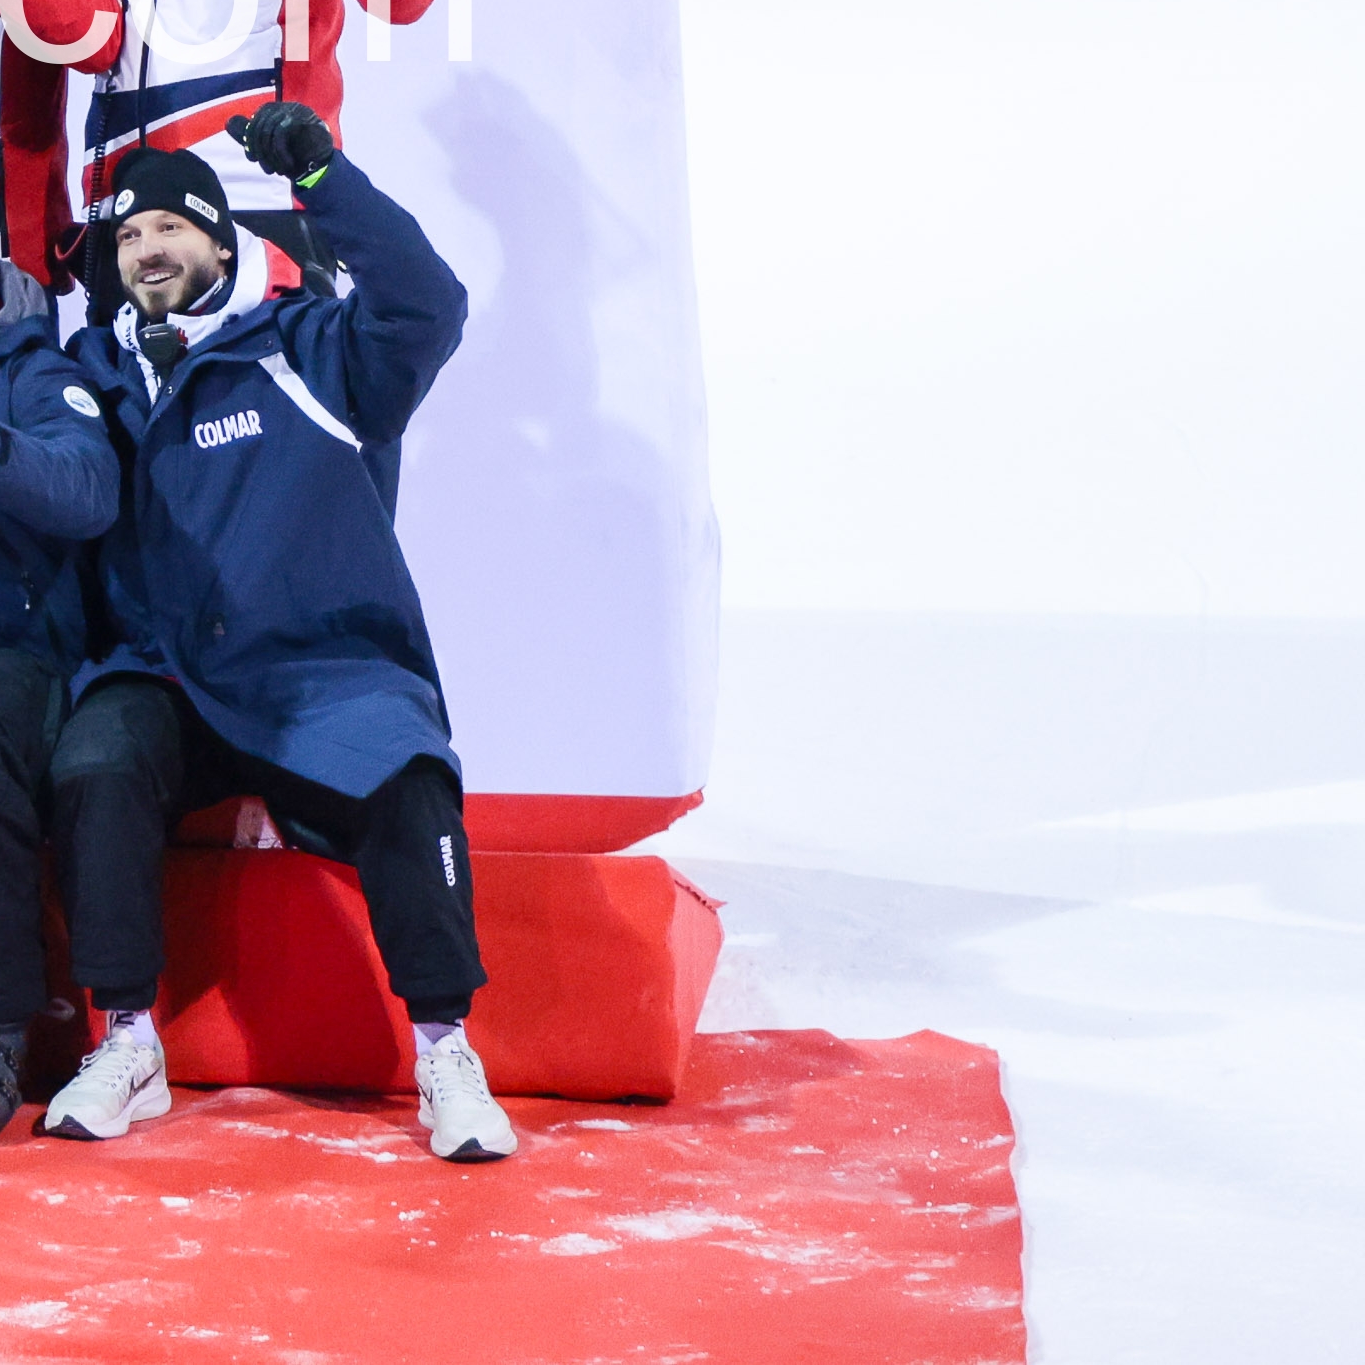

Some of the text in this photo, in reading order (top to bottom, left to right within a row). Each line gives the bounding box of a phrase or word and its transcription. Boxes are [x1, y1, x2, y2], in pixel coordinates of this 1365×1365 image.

[189, 198, 216, 219] COLMAR
[194, 409, 263, 450] COLMAR
[445, 834, 454, 887] COLMAR
